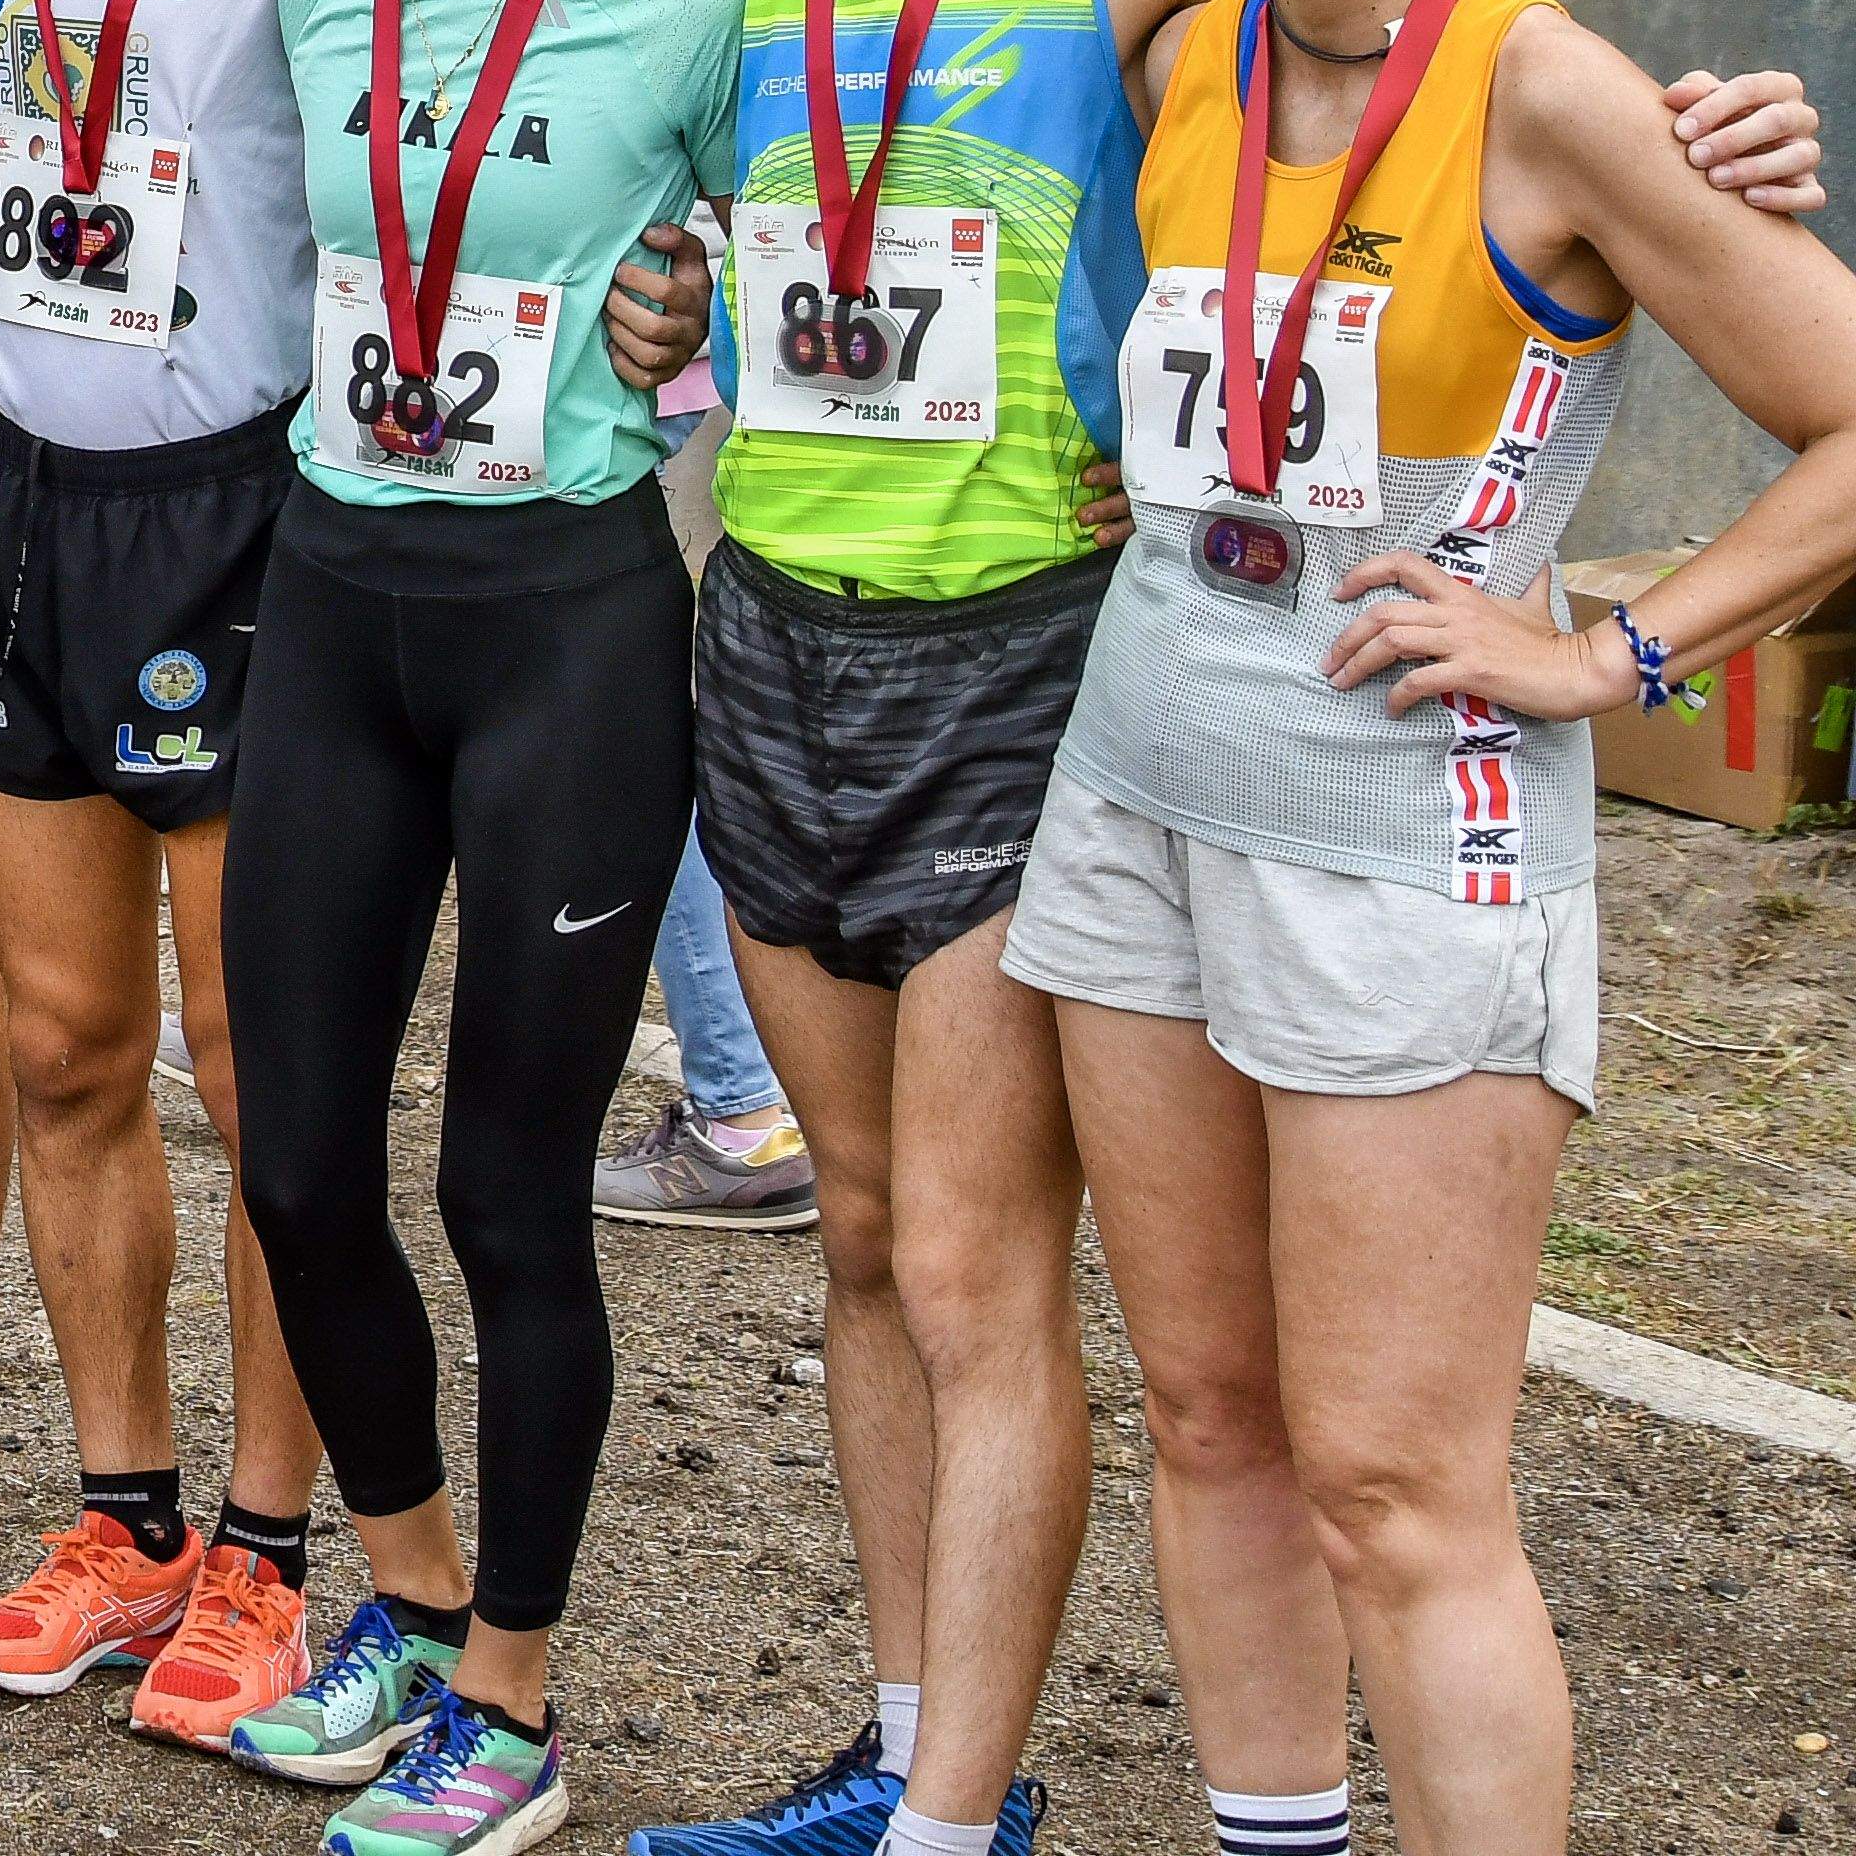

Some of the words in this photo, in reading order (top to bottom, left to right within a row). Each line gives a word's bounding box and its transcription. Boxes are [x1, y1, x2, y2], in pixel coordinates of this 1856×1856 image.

[835, 68, 1003, 91] PERFMANCE
[1353, 256, 1393, 279] TIGER
[47, 302, 88, 323] rasán
[109, 308, 159, 332] 2023
[782, 281, 943, 382] 867
[347, 333, 500, 445] 882
[854, 400, 900, 422] rasán
[924, 401, 981, 422] 2023
[406, 456, 454, 478] rasán
[477, 461, 531, 482] 2023
[1308, 484, 1365, 509] 2023
[1449, 560, 1487, 576] TIGER
[934, 852, 1030, 875] PERFORMANC
[1485, 852, 1520, 865] TIGER
